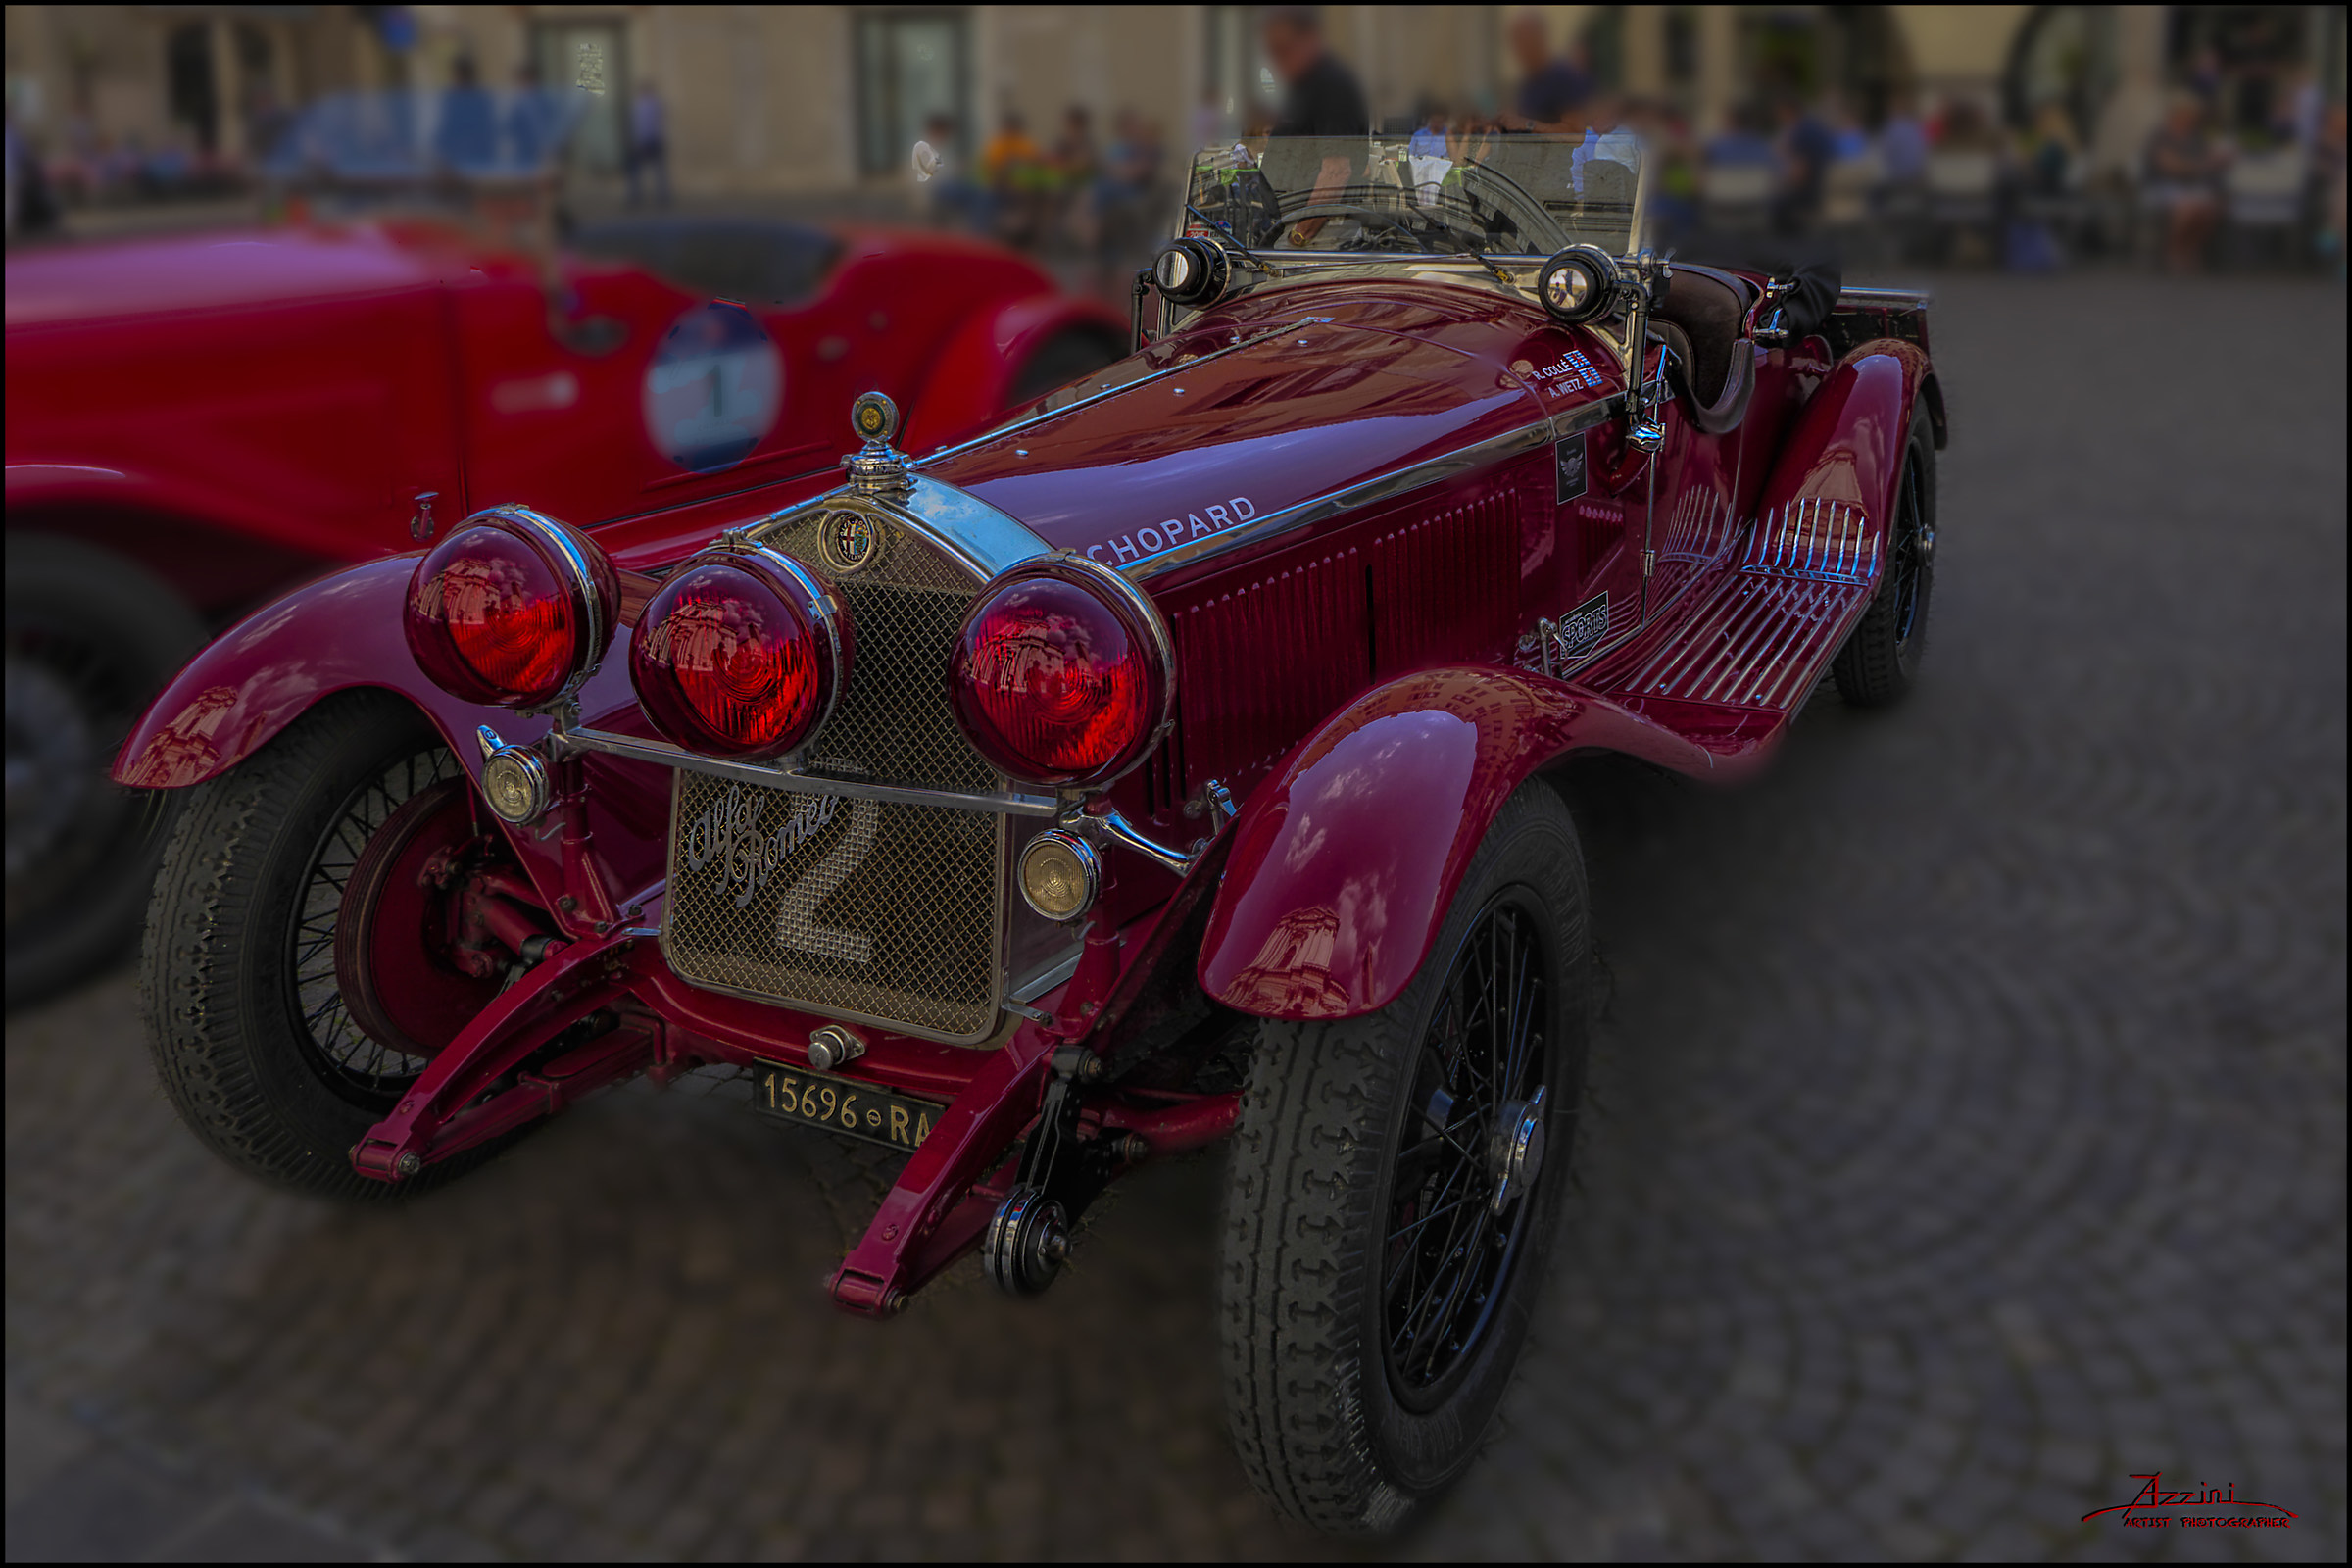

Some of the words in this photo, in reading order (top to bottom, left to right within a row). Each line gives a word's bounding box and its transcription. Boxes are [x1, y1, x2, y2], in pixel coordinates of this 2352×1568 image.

[1532, 370, 1546, 381] R.
[1547, 386, 1560, 398] A.
[1555, 378, 1584, 395] WETZ
[1562, 604, 1607, 649] SPORTS
[688, 785, 765, 895] Alfa
[764, 1073, 858, 1129] 15696
[890, 1104, 931, 1148] RA
